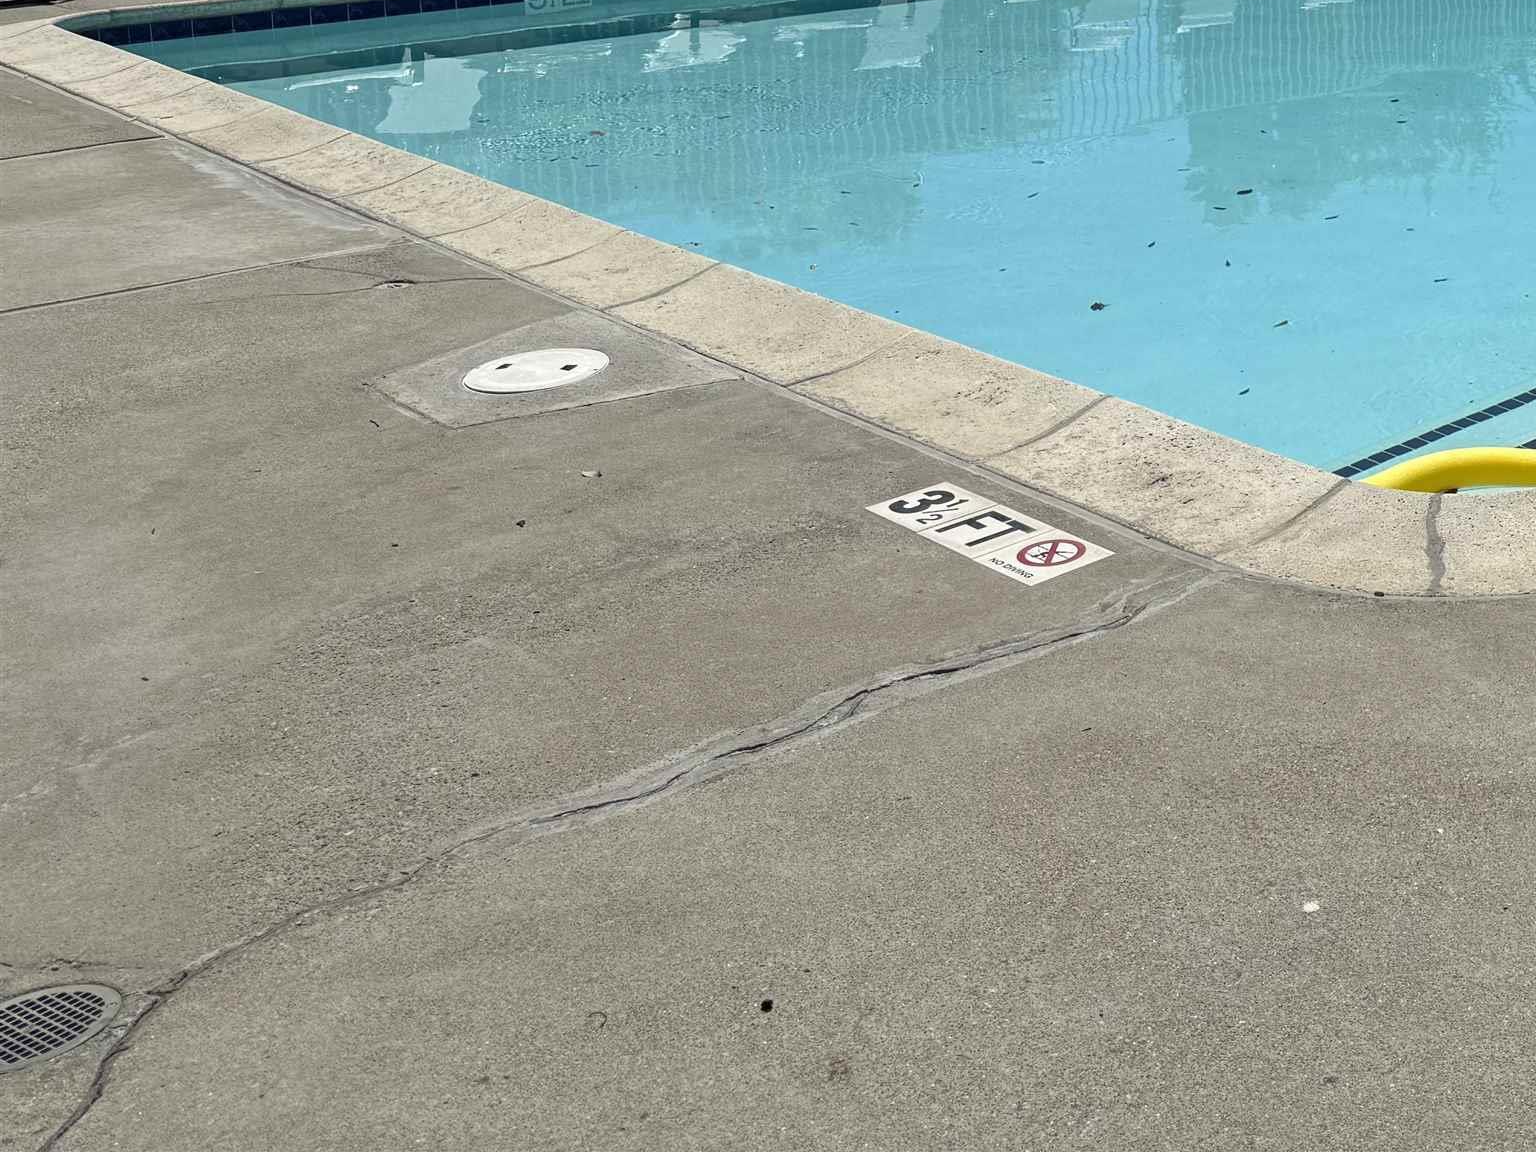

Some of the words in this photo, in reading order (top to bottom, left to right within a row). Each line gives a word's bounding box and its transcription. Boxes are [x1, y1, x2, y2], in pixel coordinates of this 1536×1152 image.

[935, 510, 1037, 547] FT
[990, 557, 1005, 566] NO
[1002, 563, 1034, 579] DIVING
